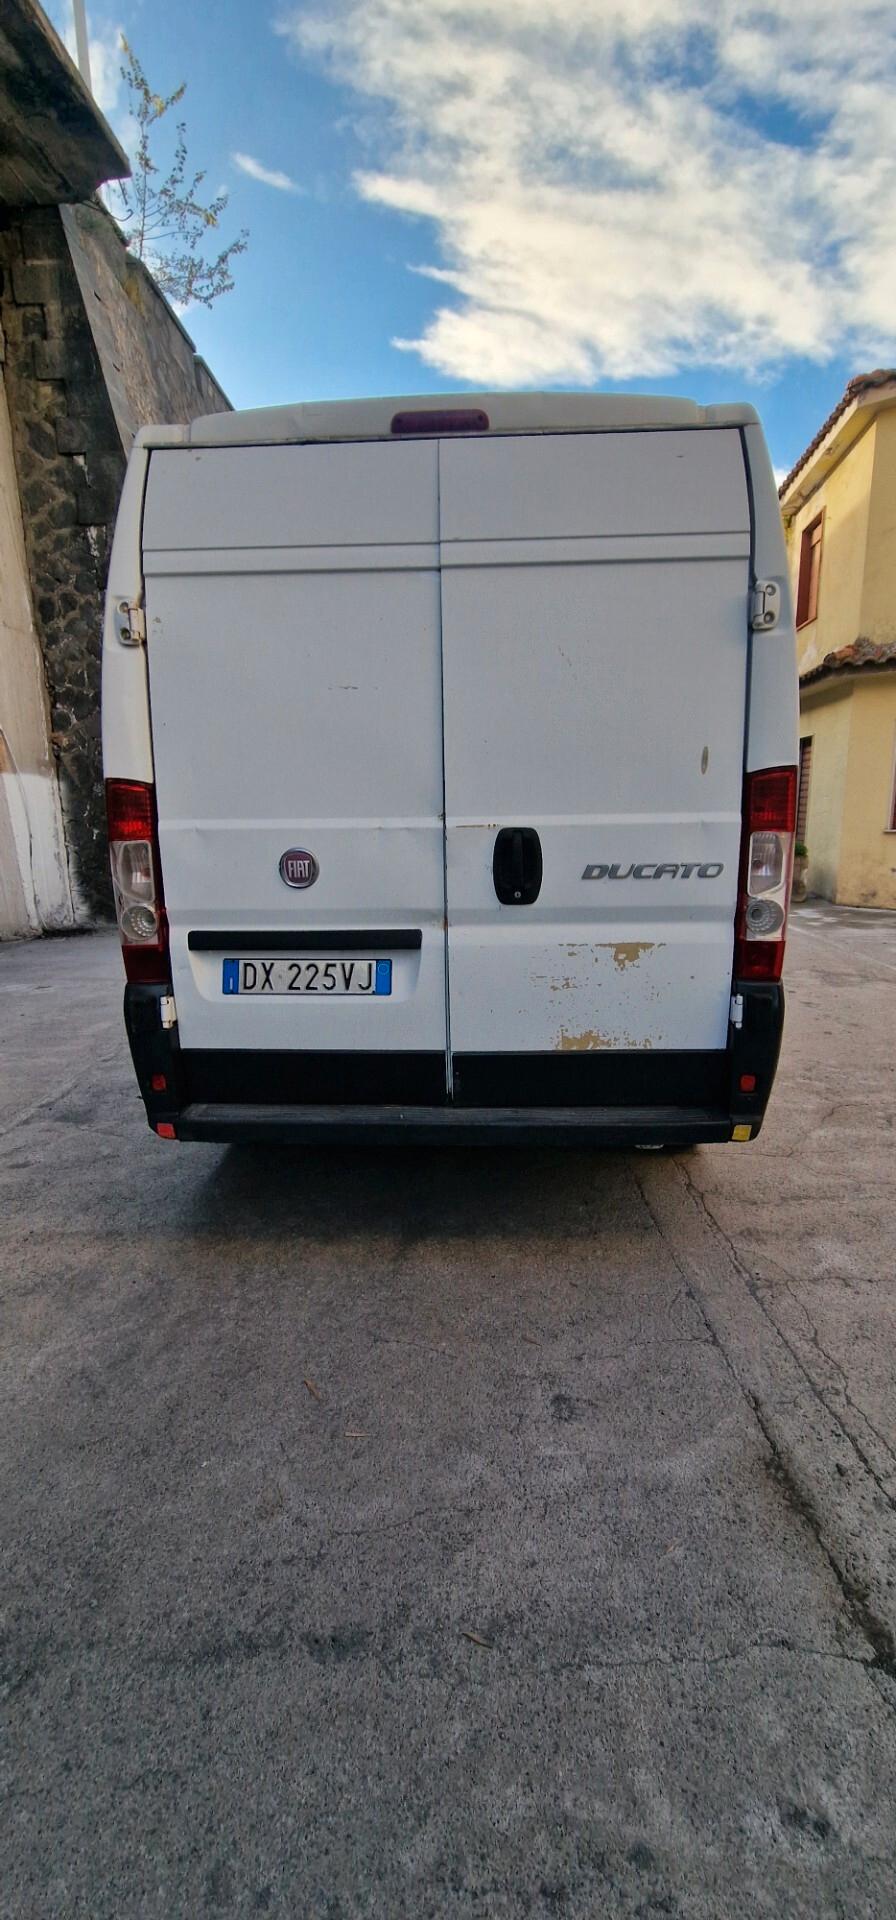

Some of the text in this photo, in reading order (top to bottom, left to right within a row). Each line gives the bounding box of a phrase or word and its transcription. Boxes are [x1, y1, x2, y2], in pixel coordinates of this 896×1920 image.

[288, 860, 310, 878] FIAT
[581, 862, 725, 880] DUCATO
[243, 962, 373, 991] DX 225VJ
